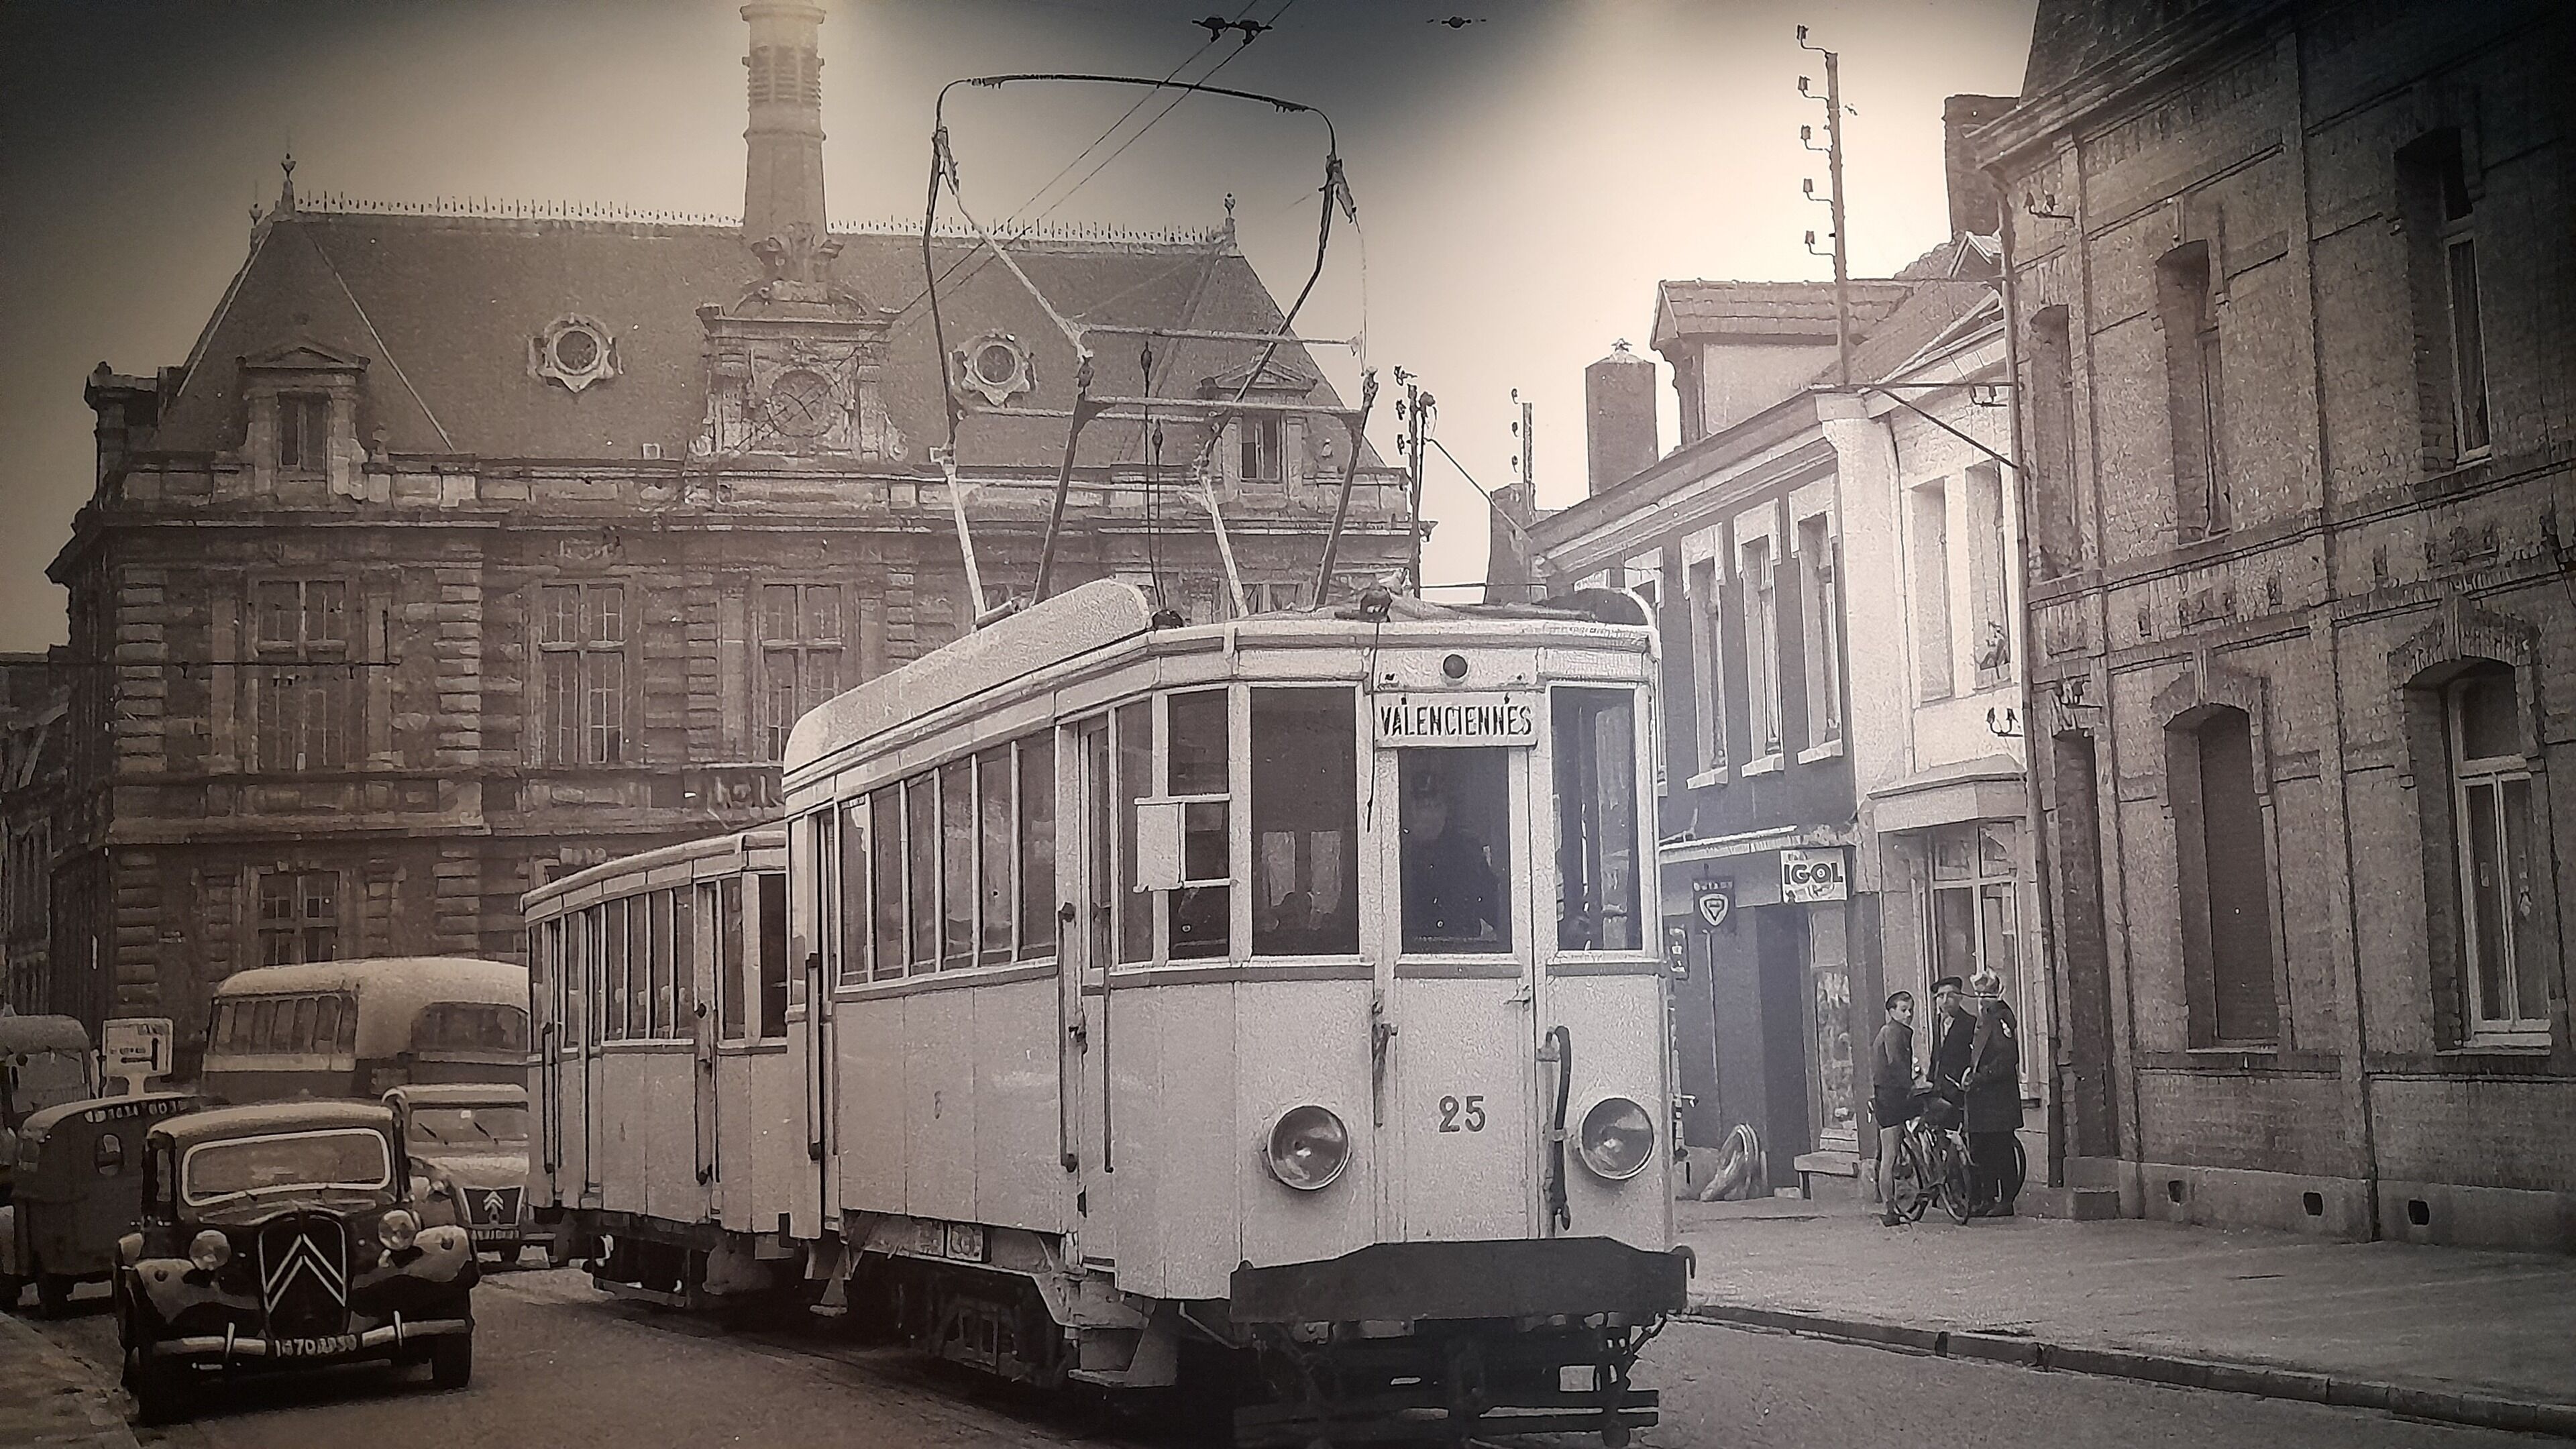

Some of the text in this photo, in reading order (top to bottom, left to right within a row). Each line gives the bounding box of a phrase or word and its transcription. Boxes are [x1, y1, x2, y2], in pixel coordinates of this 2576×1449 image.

[1380, 705, 1533, 737] VALENCIENNES
[1784, 861, 1844, 885] IGOL
[1438, 1095, 1487, 1133] 25
